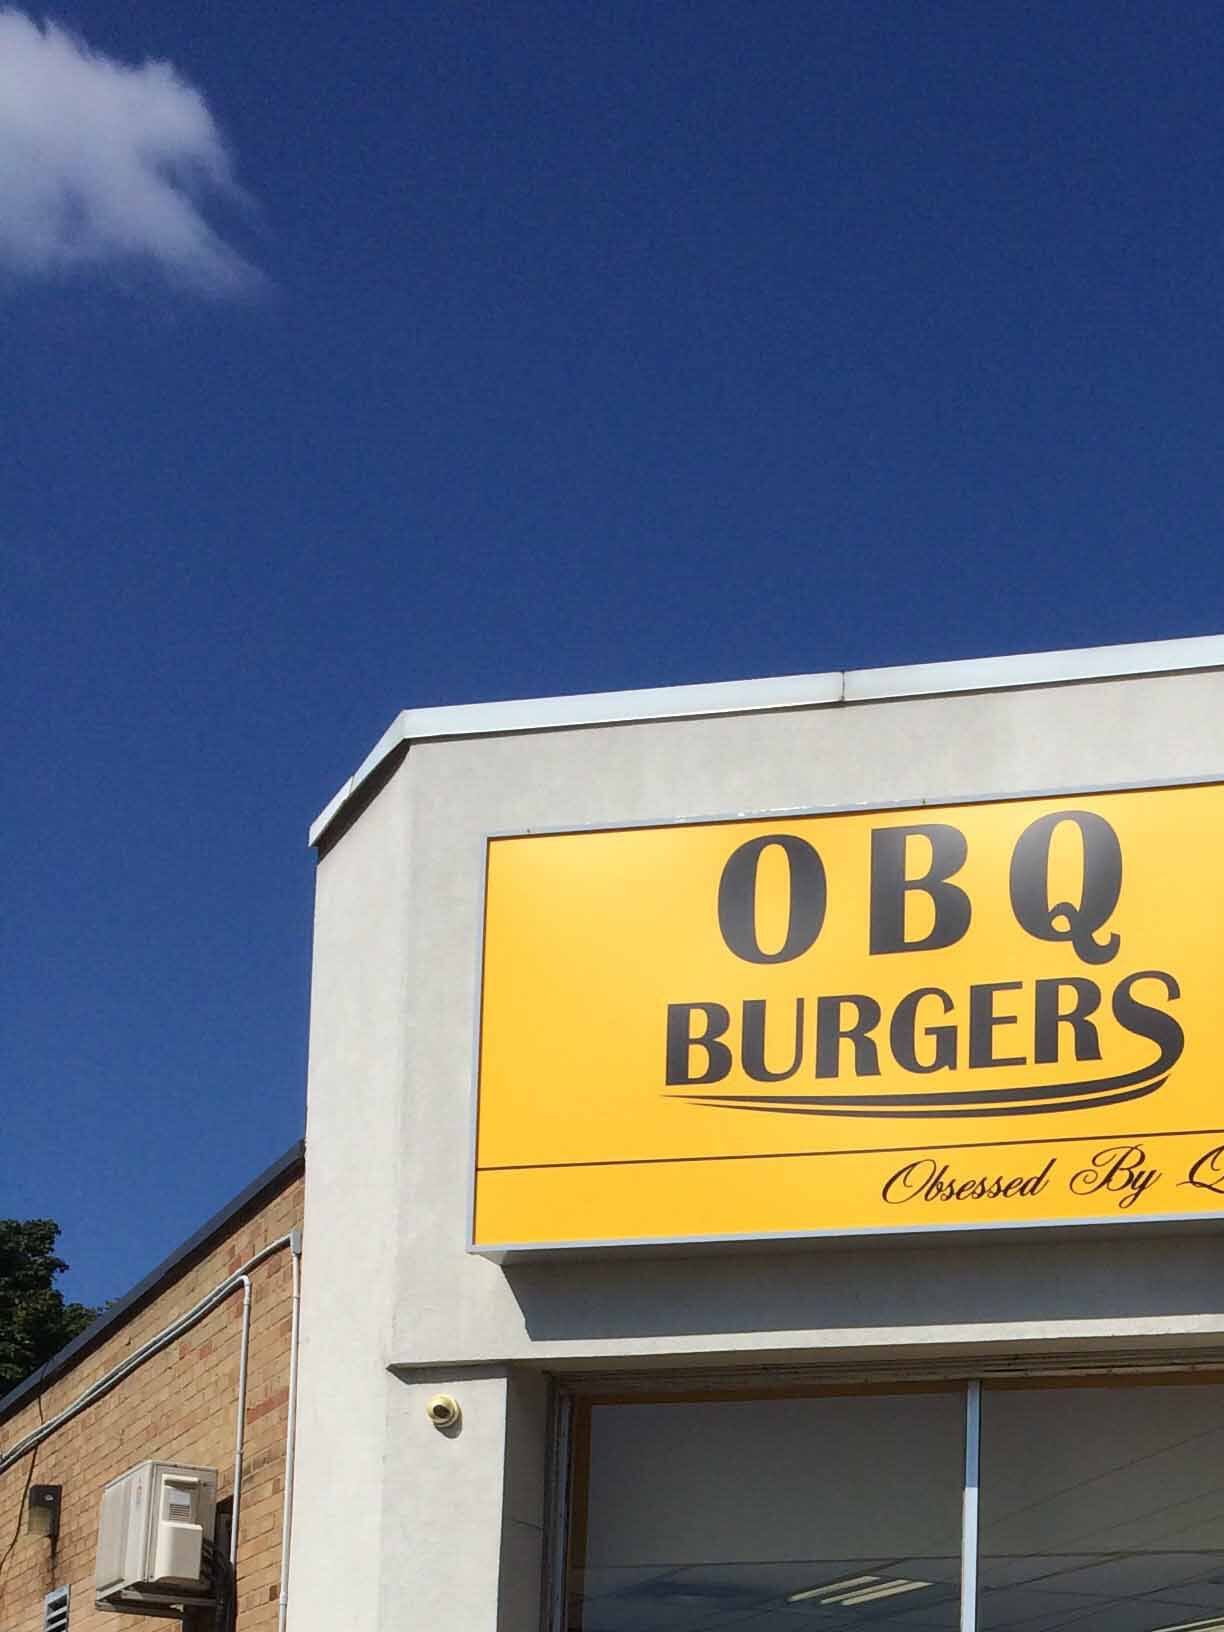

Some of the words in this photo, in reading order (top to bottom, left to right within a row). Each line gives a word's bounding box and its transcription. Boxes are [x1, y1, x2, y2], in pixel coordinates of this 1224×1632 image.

[663, 970, 1186, 1105] BURGERS
[882, 1157, 1056, 1206] Obsessed
[1069, 1144, 1162, 1211] By
